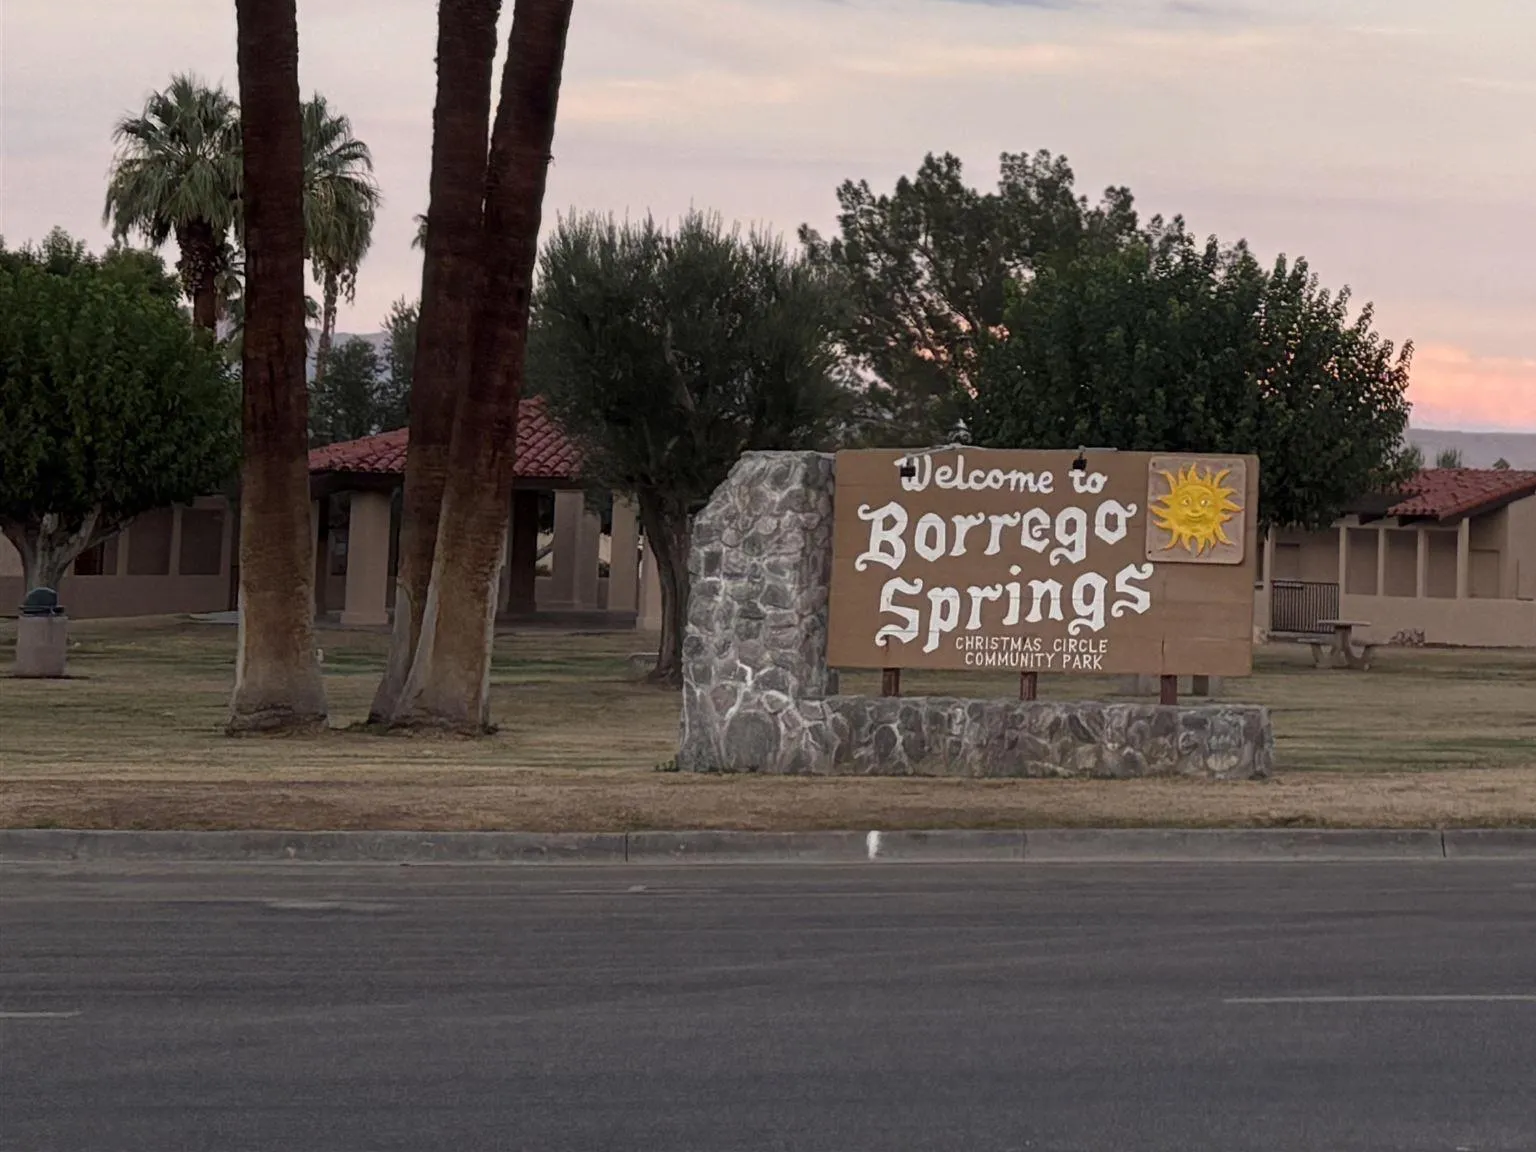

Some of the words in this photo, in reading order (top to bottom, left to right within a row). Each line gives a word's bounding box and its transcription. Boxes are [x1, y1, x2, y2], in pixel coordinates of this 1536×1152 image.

[893, 453, 1054, 494] Welcome
[1068, 468, 1108, 493] to
[855, 499, 1137, 572] Borrego
[875, 563, 1154, 653] Springs
[955, 636, 1042, 652] CHRISTMAS
[1053, 638, 1108, 654] CIRCLE
[965, 651, 1055, 668] COMMUNITY
[1062, 653, 1103, 670] PARK
